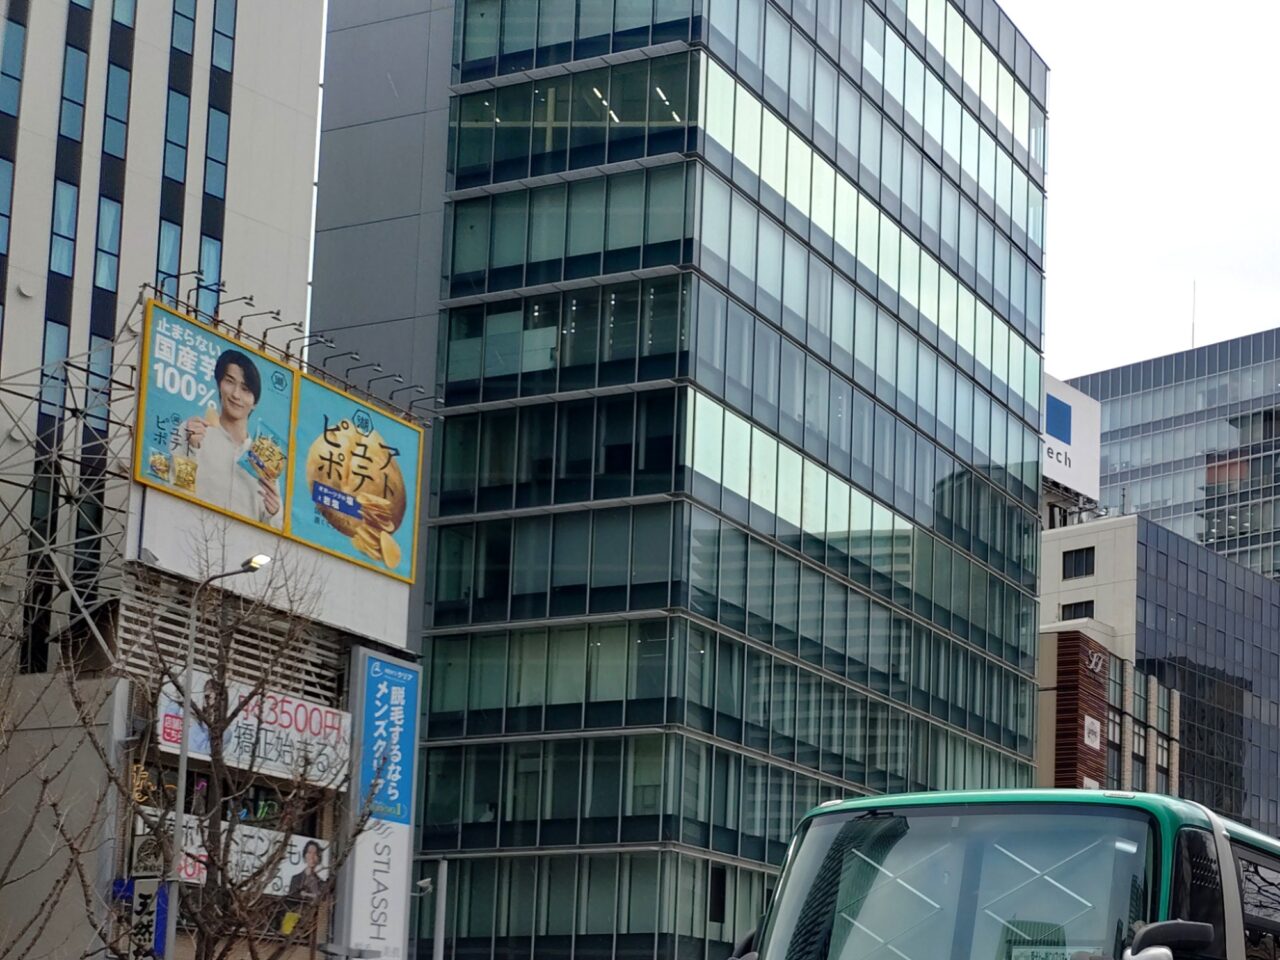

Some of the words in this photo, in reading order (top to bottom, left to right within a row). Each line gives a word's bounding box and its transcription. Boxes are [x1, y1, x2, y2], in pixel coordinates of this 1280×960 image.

[155, 317, 222, 357] 止まらない
[153, 362, 217, 411] 100%
[387, 686, 406, 801] 脱毛するなら
[369, 842, 391, 941] STLASSH
